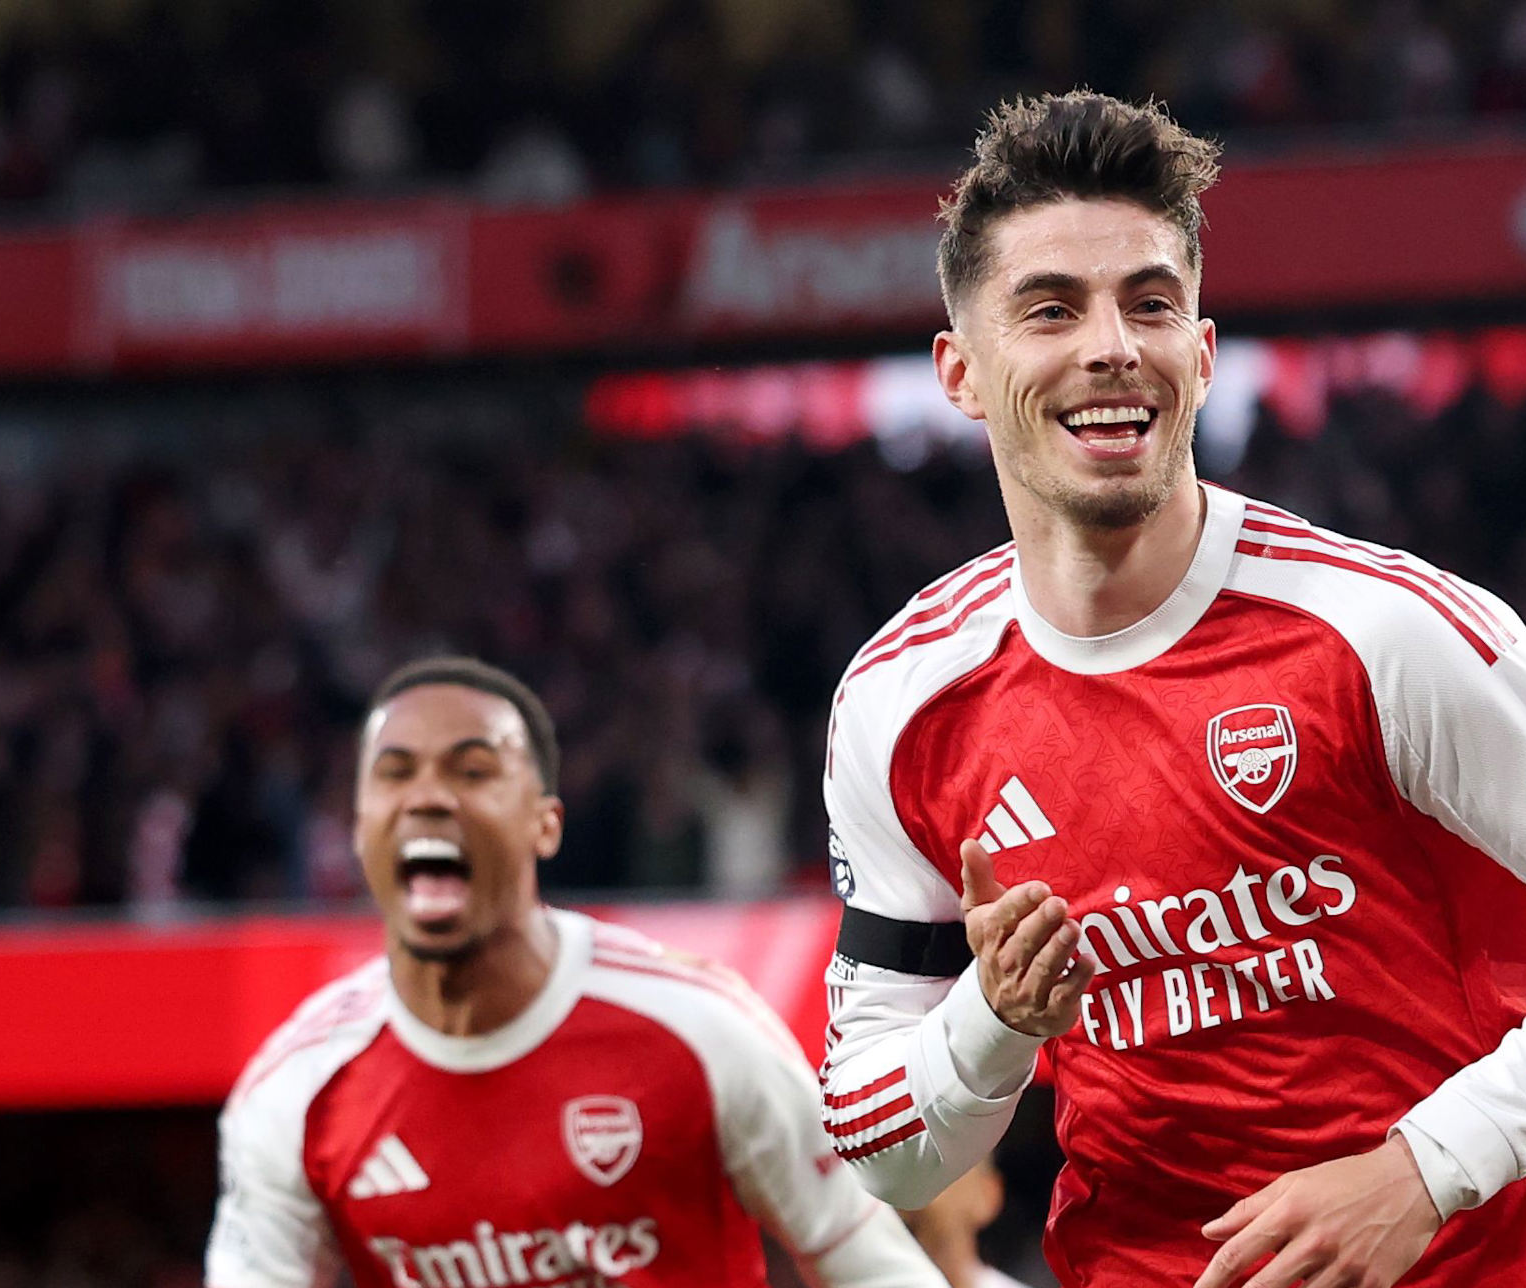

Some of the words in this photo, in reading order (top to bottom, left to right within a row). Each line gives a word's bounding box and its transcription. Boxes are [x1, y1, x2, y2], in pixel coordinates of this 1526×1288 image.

[1219, 720, 1282, 746] Arsenal
[1075, 854, 1357, 976] mirates
[1081, 977, 1144, 1050] FLY
[1163, 939, 1336, 1036] BETTER
